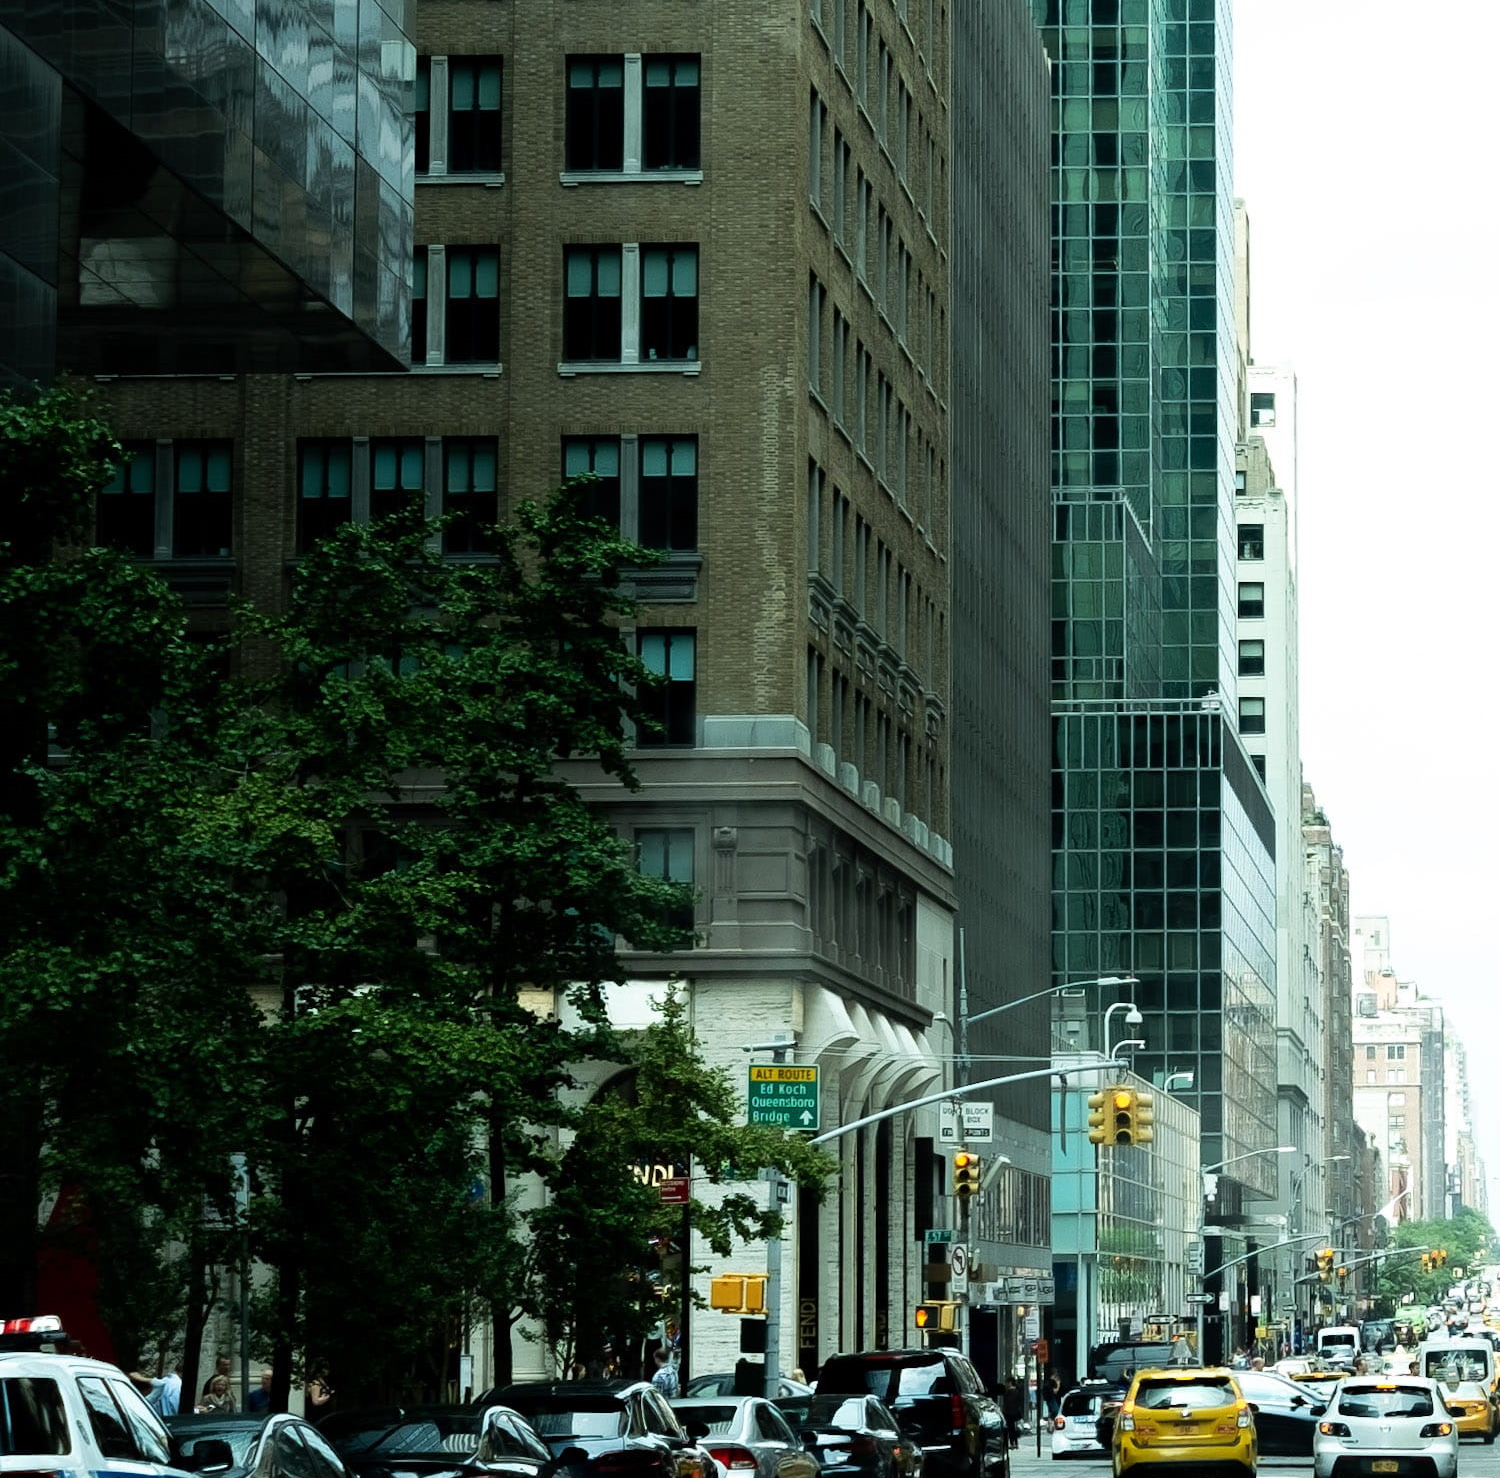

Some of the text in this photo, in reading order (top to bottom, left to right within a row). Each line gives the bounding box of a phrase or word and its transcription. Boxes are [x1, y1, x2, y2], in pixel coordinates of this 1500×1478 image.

[756, 1069, 812, 1080] ALT ROUTE
[760, 1083, 806, 1094] Ed Koch
[751, 1096, 815, 1108] Queensboro
[752, 1110, 790, 1125] Bridge
[800, 1297, 816, 1349] FENDI
